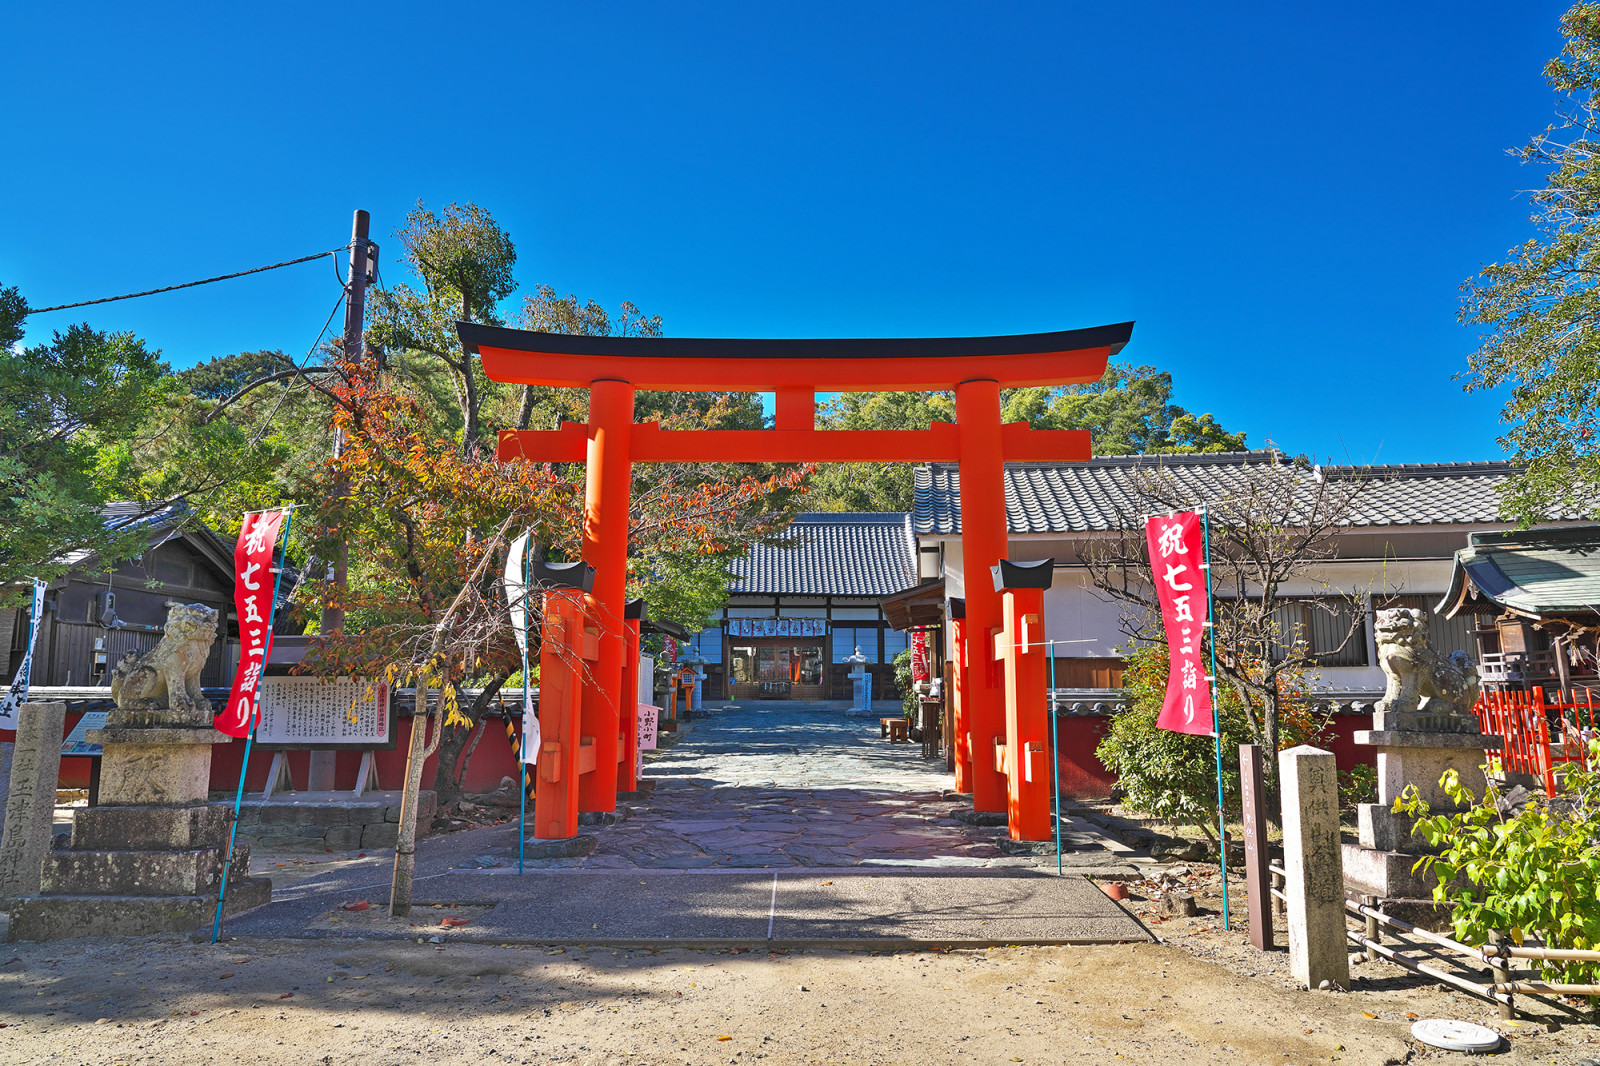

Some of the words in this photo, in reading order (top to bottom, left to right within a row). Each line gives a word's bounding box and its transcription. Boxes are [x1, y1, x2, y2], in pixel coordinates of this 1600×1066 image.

[235, 522, 269, 728] 祝七五三詣り
[1158, 523, 1196, 725] 祝七五三詣り
[643, 710, 655, 742] 小野小町
